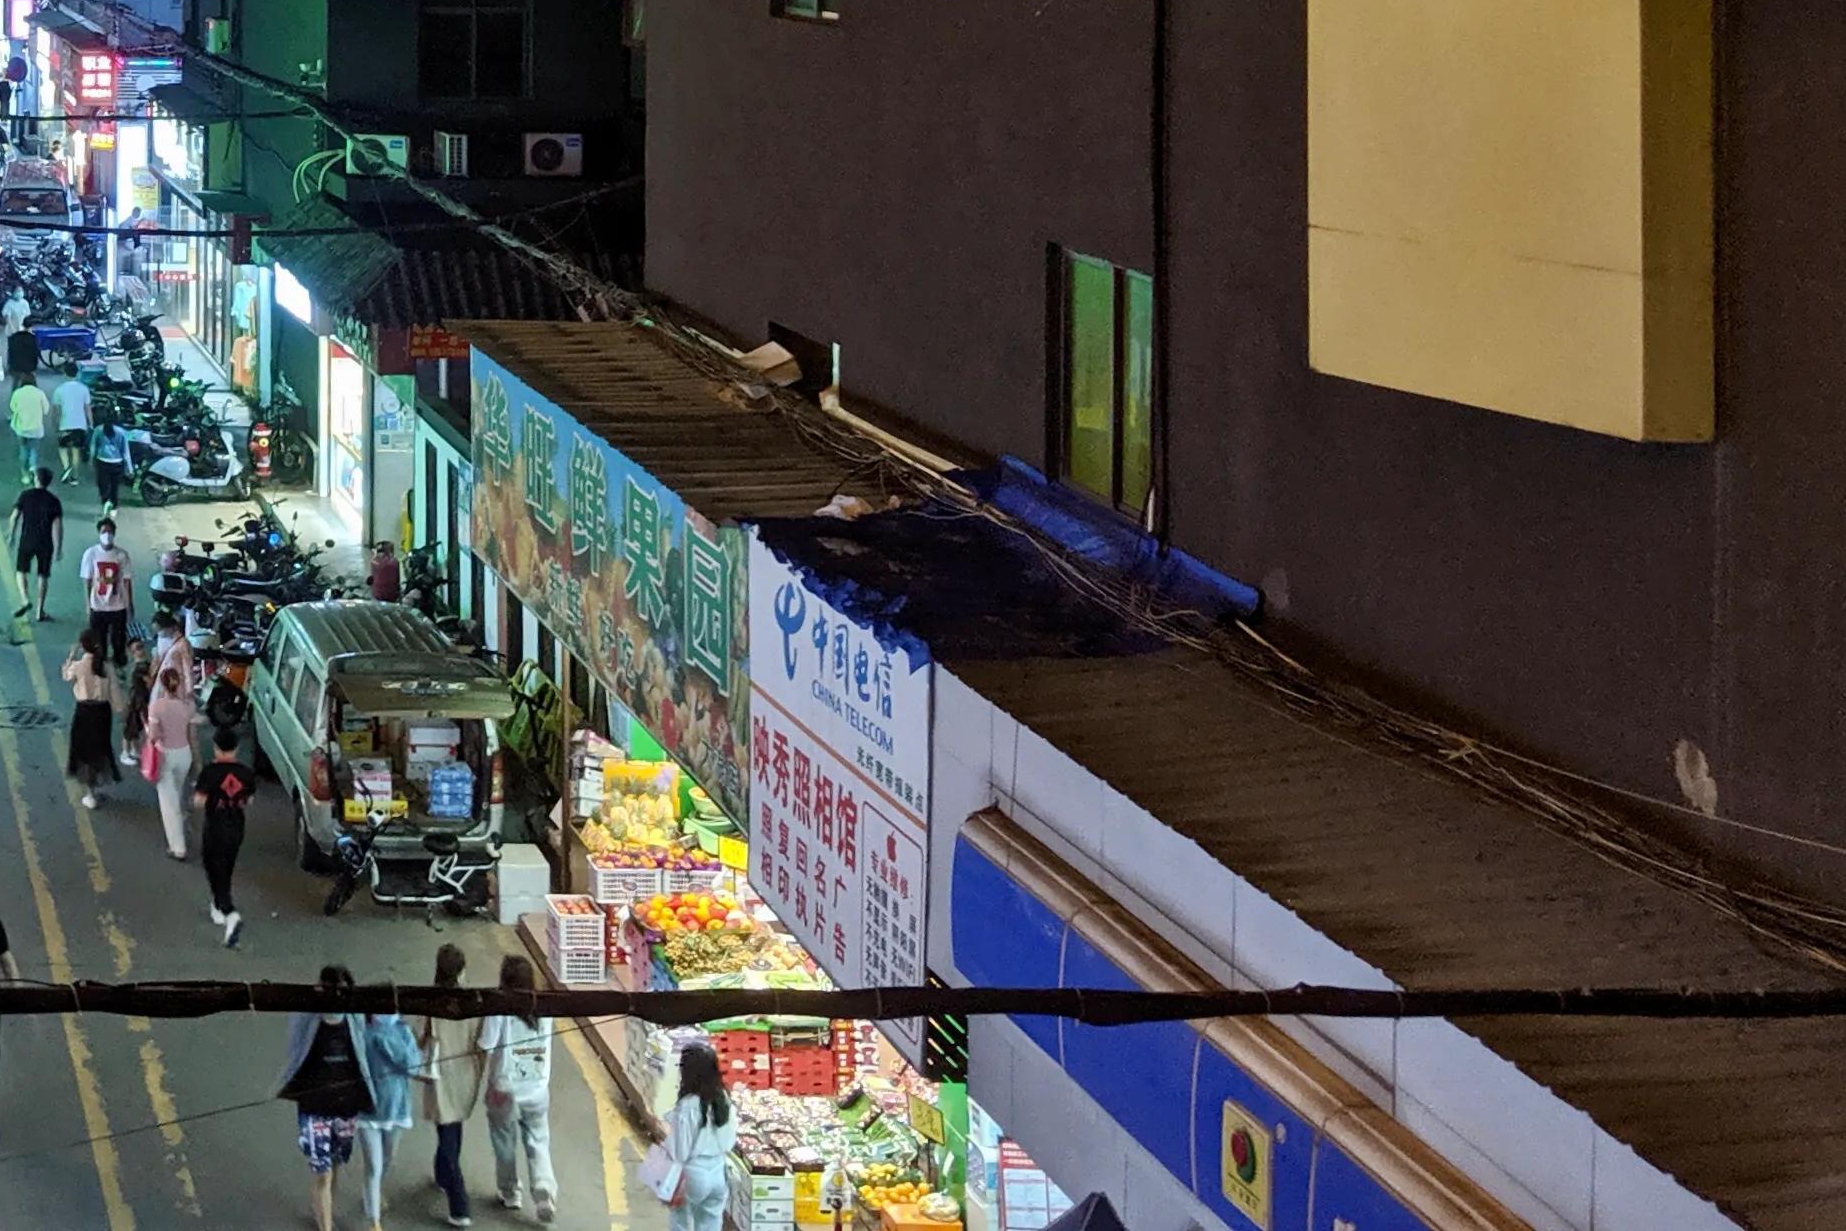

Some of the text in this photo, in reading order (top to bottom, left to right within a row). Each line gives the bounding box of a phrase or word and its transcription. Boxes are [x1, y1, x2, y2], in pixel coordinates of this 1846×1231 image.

[480, 371, 733, 699] 华旺鲜果园
[811, 603, 893, 720] 中国电信
[811, 678, 895, 756] CHINA TELECOM
[753, 714, 859, 875] 映秀照相馆
[777, 818, 790, 906] 复印
[795, 836, 808, 927] 回执
[813, 854, 827, 946] 名片
[832, 874, 848, 966] 广告
